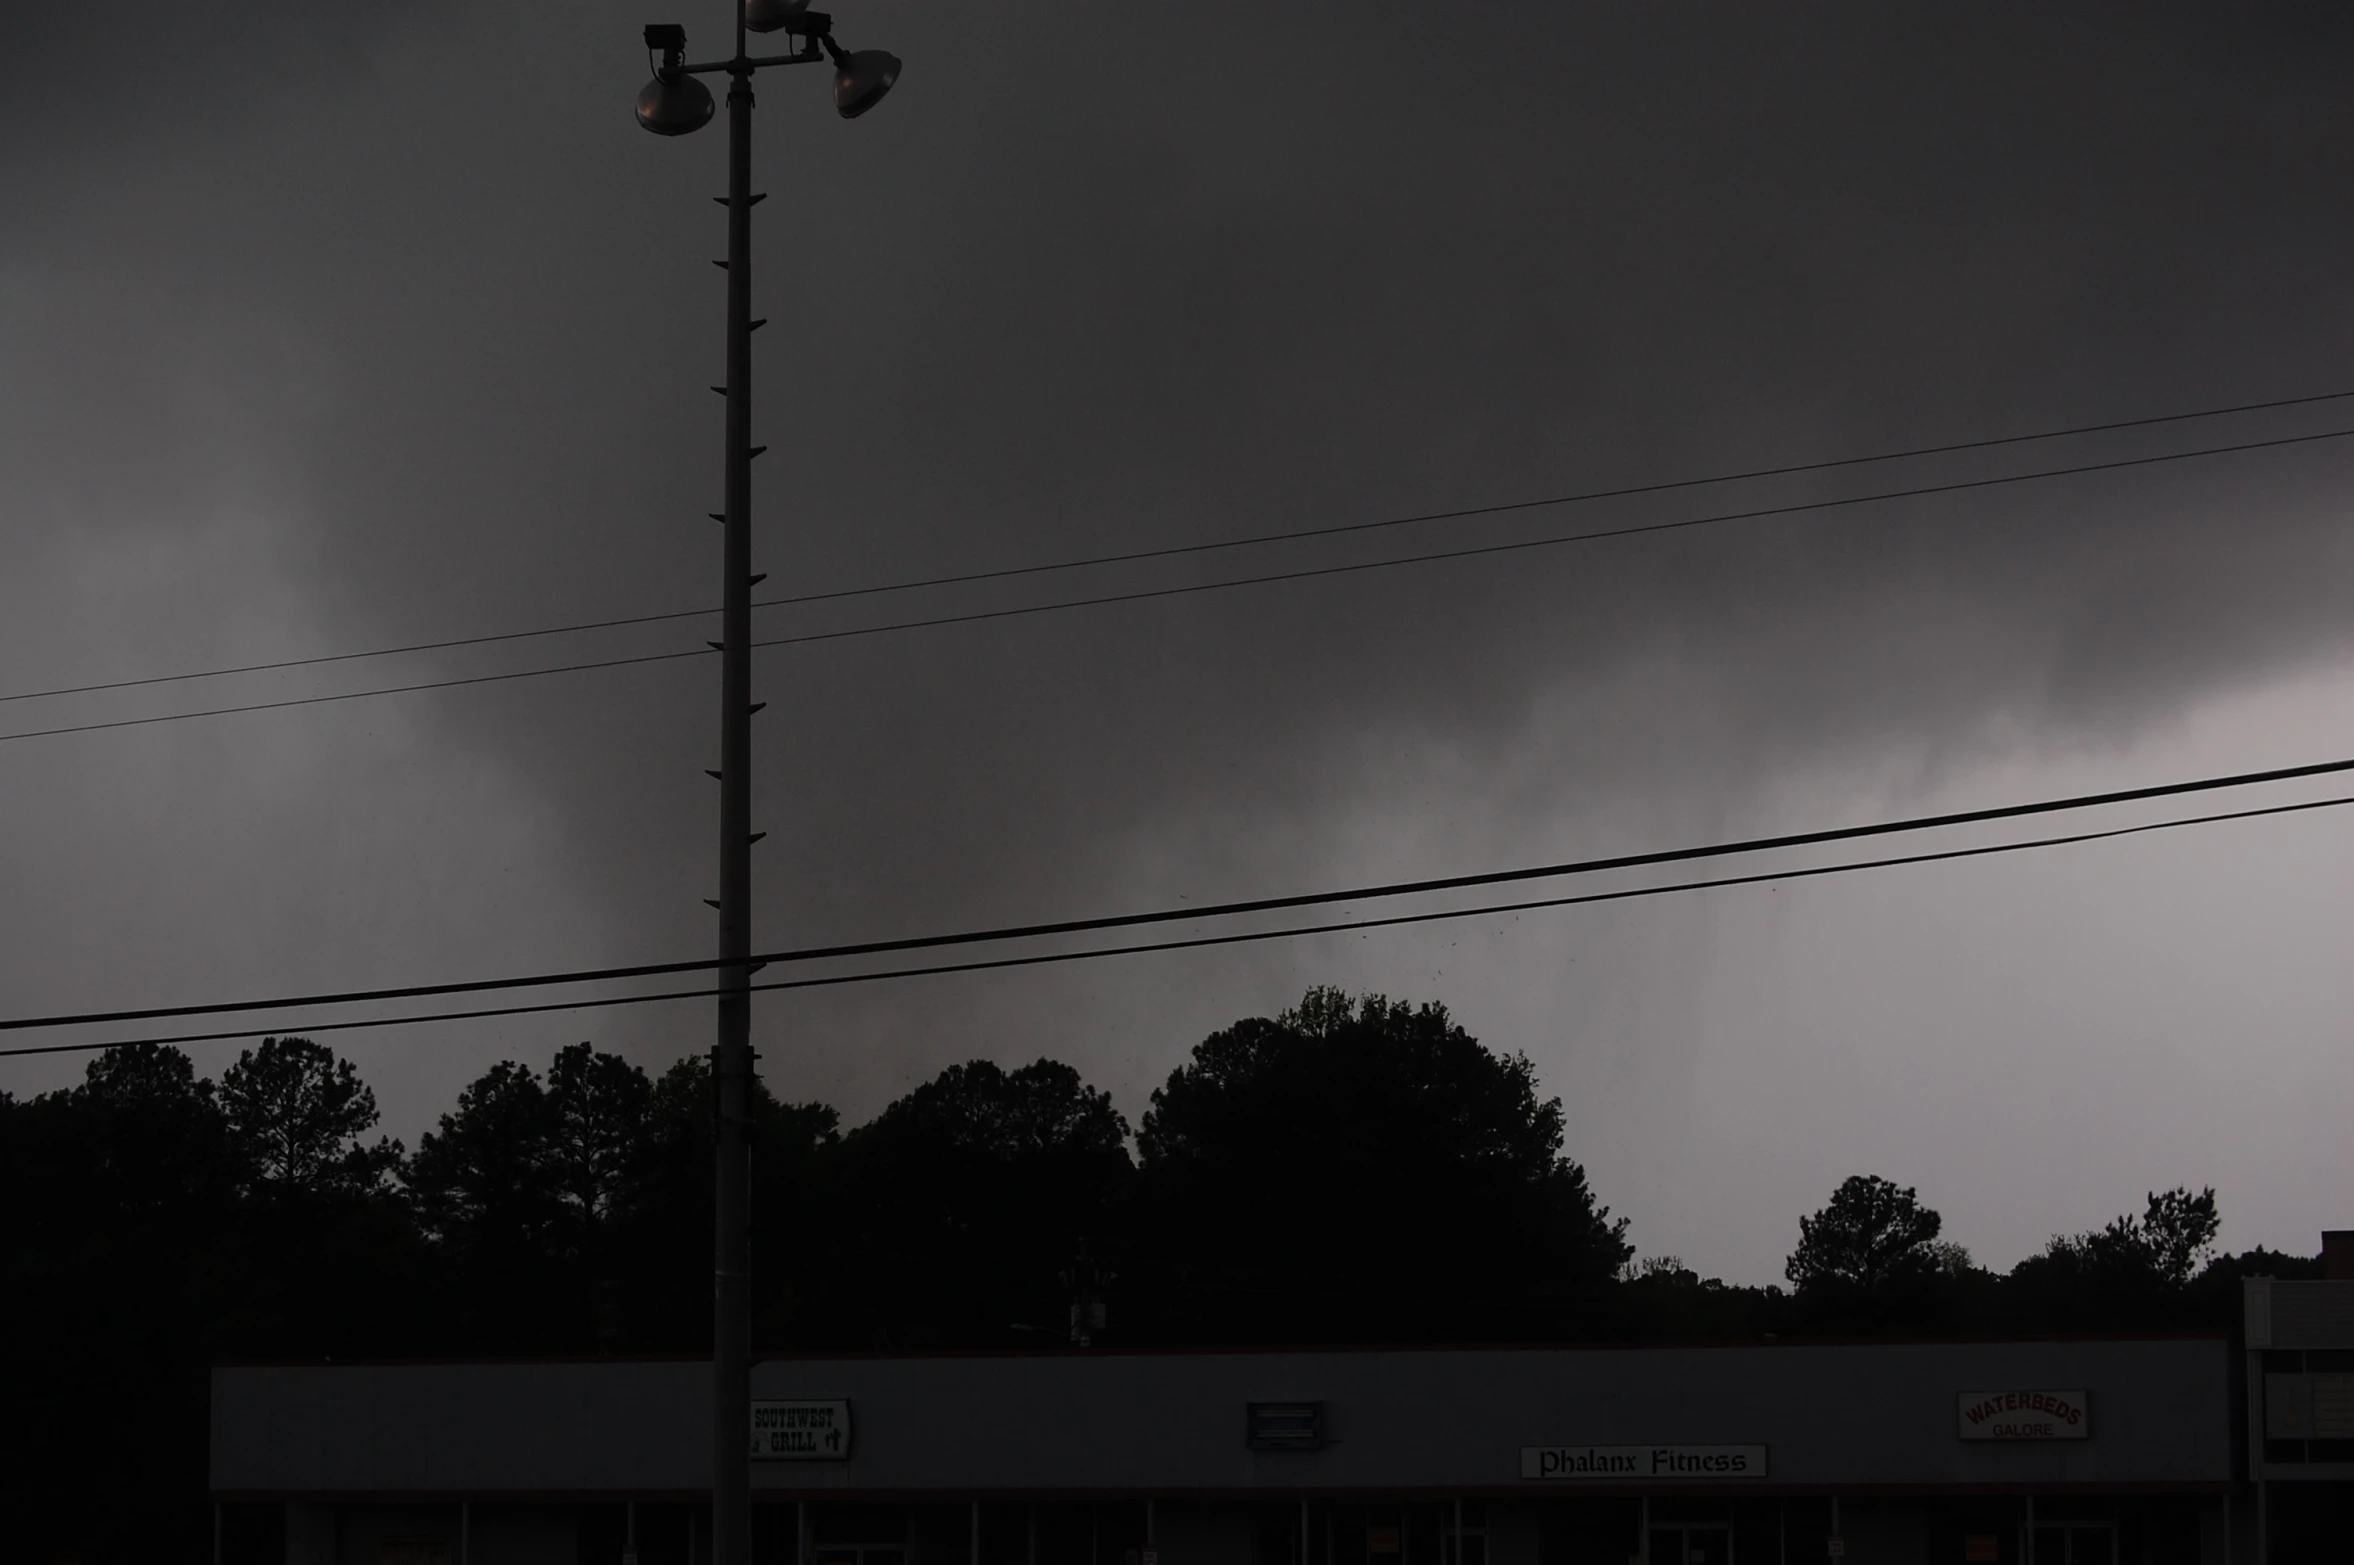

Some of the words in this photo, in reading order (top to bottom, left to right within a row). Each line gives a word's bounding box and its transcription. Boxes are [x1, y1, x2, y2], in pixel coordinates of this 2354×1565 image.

[755, 1407, 834, 1428] SOUTHWEST
[1965, 1393, 2082, 1426] WATERBEDS
[1992, 1423, 2054, 1437] GALORE
[771, 1431, 817, 1452] GRILL
[1540, 1448, 1637, 1477] Phalanx
[1651, 1448, 1747, 1474] Fitness
